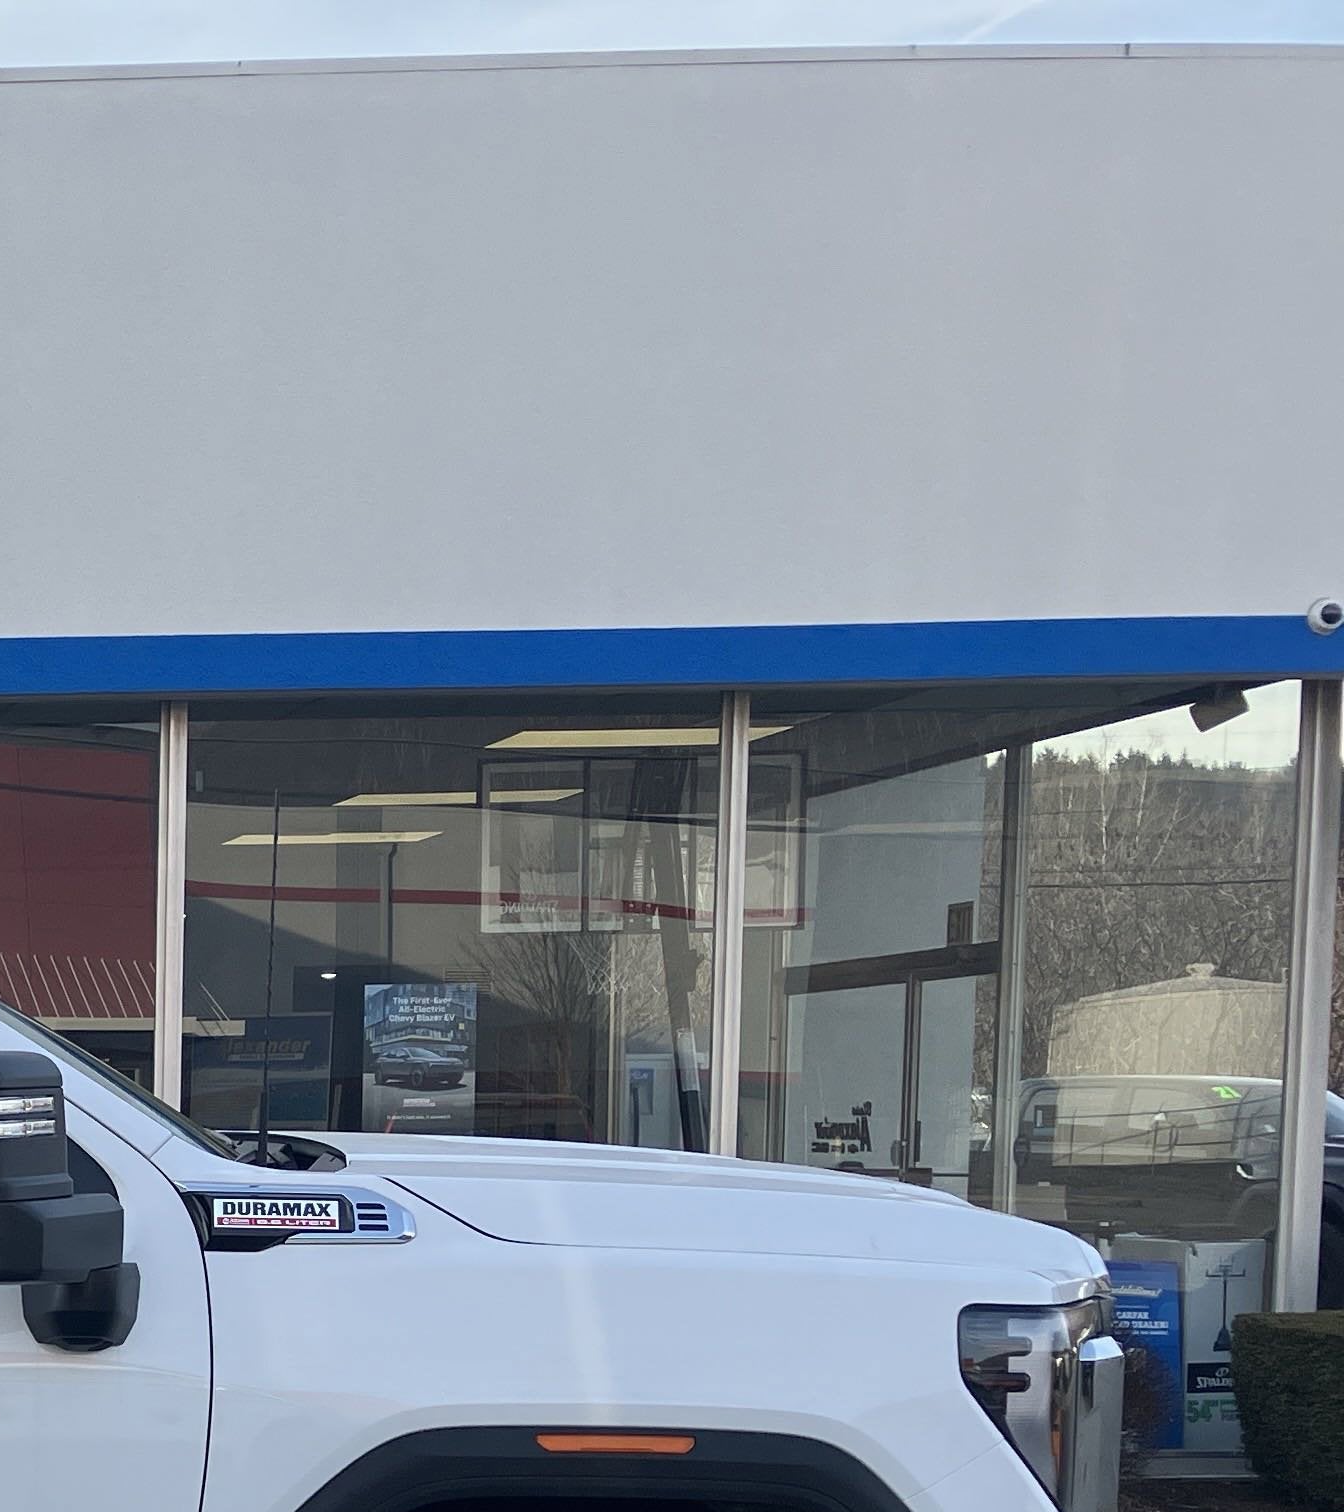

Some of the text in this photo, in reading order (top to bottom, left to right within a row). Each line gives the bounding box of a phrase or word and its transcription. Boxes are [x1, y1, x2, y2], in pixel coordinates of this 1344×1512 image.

[392, 996, 452, 1005] The First-Ever
[399, 1005, 446, 1013] All-Electric
[388, 1013, 456, 1023] Chevy Blazer EV
[222, 1039, 312, 1054] lexander
[222, 1201, 332, 1217] DURAMAX
[285, 1219, 331, 1227] LITER
[1116, 1311, 1150, 1320] CARFAX
